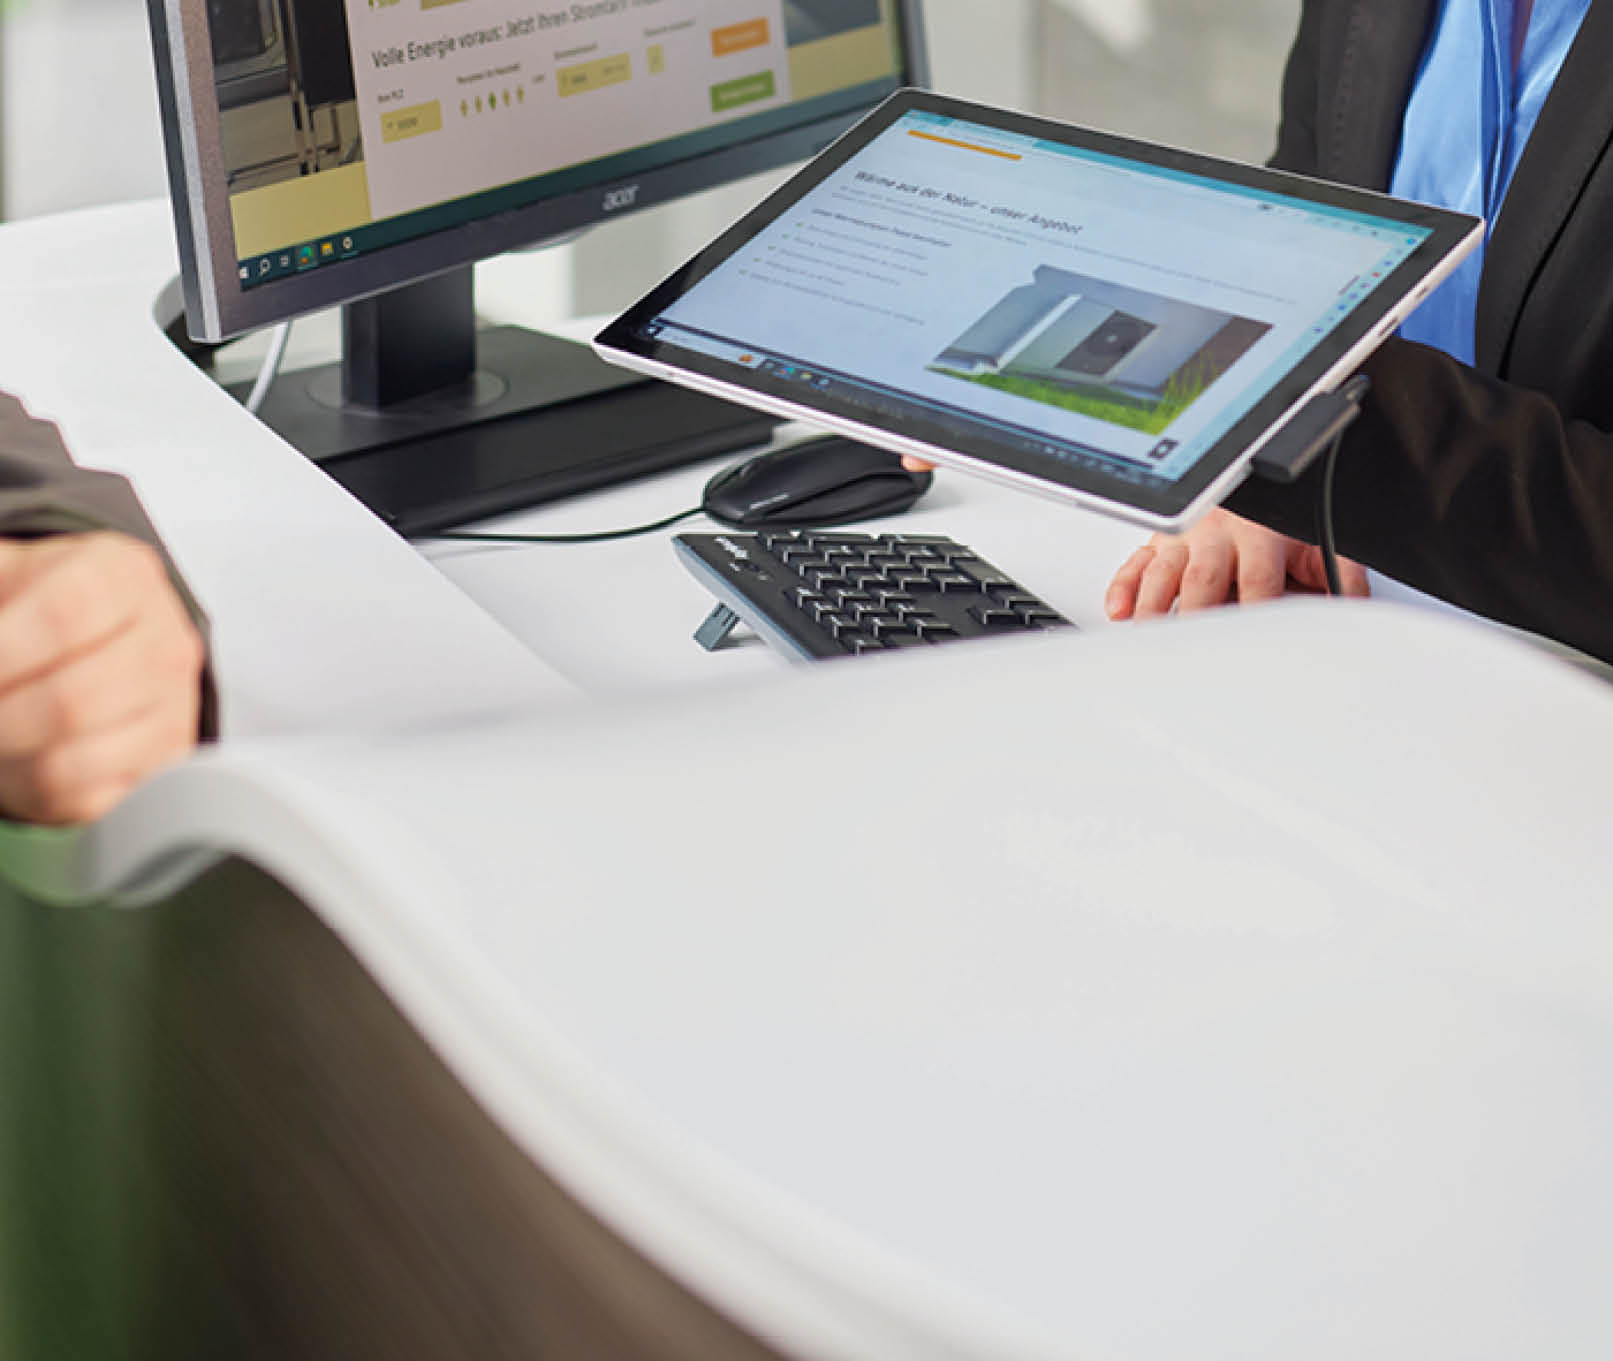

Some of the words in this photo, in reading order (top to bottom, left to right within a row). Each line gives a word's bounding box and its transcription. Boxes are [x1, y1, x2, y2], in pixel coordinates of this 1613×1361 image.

[371, 45, 405, 69] Volle
[407, 35, 456, 59] Energie
[506, 17, 534, 38] Jetzt
[538, 9, 568, 30] Ihren
[602, 184, 639, 212] acer
[855, 169, 896, 189] Wärme
[896, 181, 919, 194] aus
[920, 187, 941, 198] der
[942, 191, 979, 208] Natur
[989, 205, 1028, 220] unser
[1028, 213, 1083, 234] Angebot
